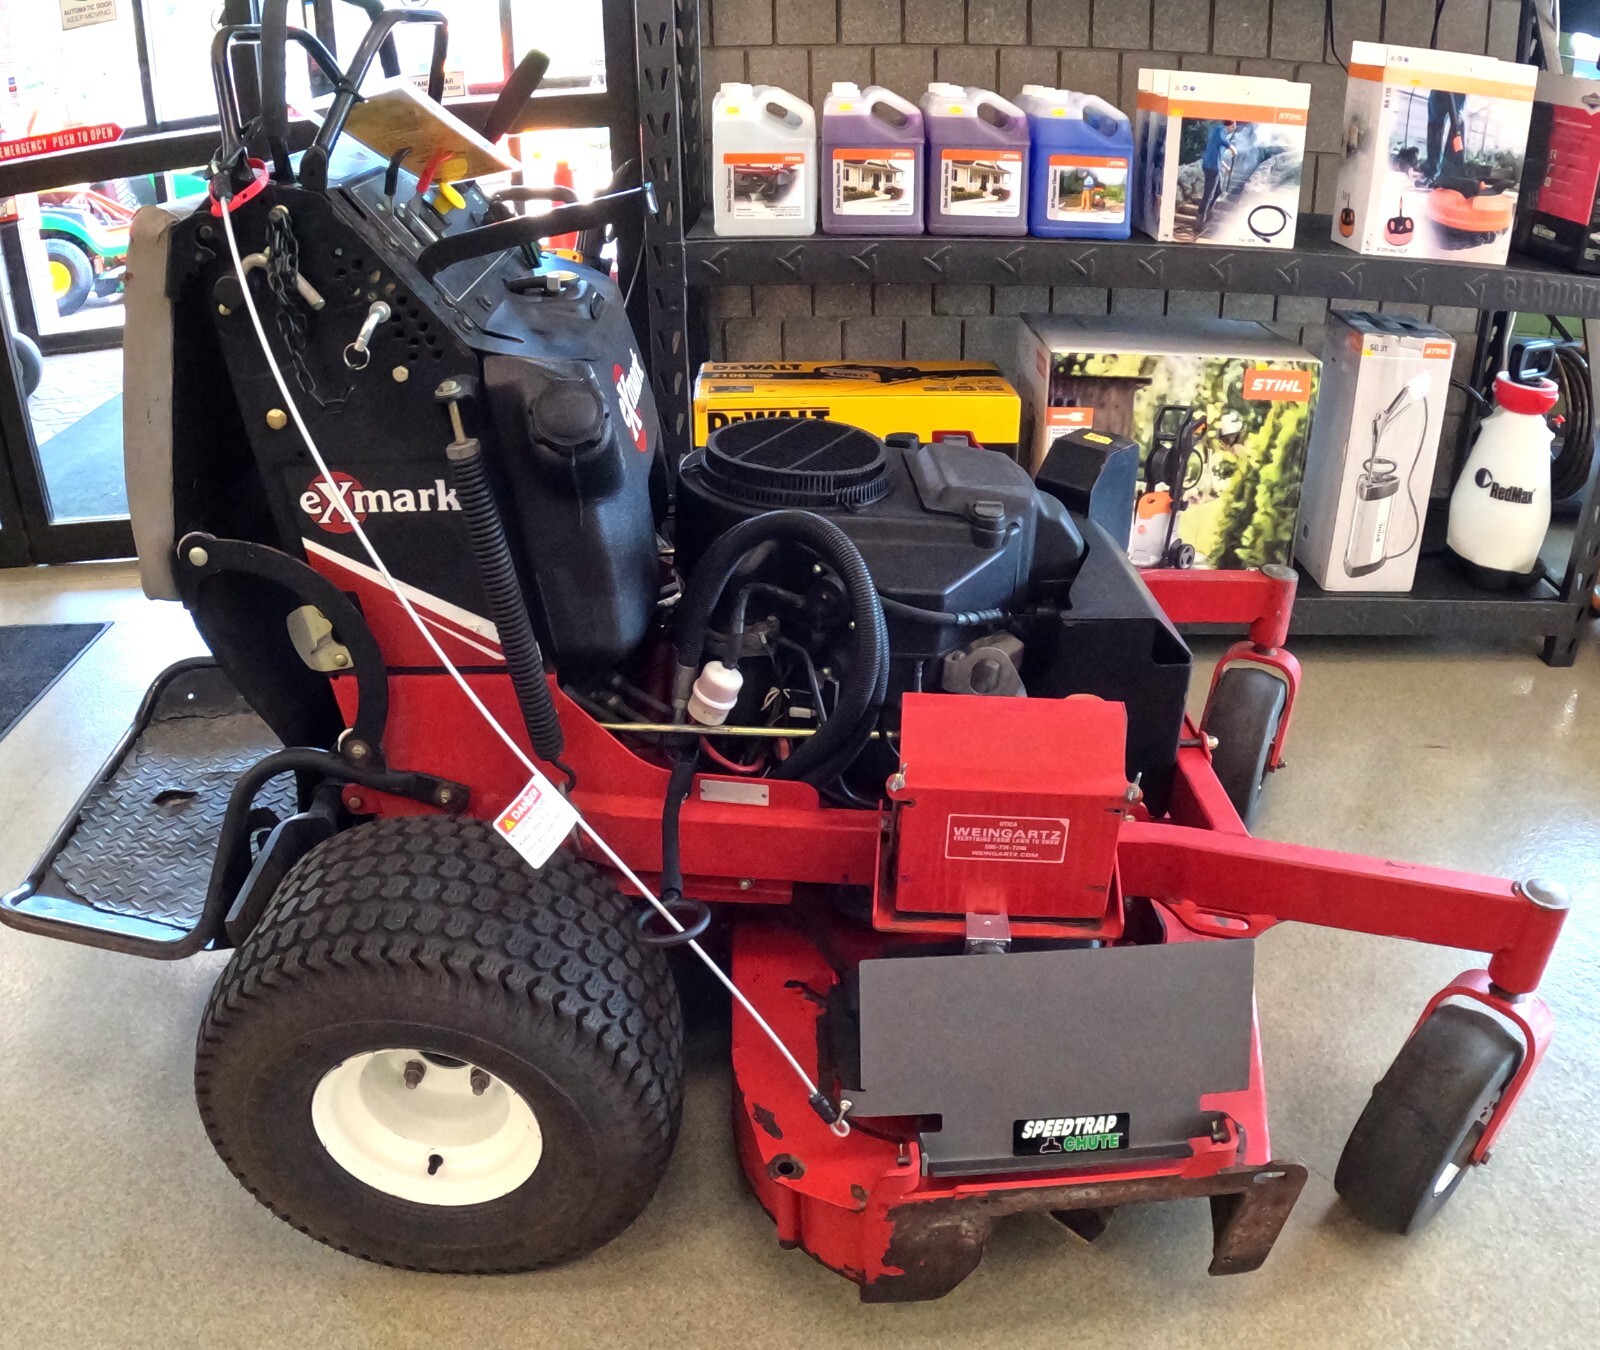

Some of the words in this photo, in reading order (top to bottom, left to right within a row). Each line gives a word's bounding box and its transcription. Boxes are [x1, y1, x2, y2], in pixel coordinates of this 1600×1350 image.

[64, 4, 95, 15] AUTOMATIC
[96, 1, 112, 9] DOOR
[67, 14, 84, 23] KEEP
[85, 9, 111, 19] MOVING
[1278, 112, 1304, 121] STIHL
[0, 138, 47, 158] EMERGENCY
[52, 132, 76, 148] PUSH
[77, 130, 88, 144] TO
[90, 126, 114, 141] OPEN
[1369, 343, 1379, 351] SG
[1424, 346, 1449, 355] STIHL
[1250, 378, 1303, 393] STIHL
[1490, 481, 1534, 505] RedMax
[511, 787, 541, 821] DANGER
[953, 826, 1061, 840] WEINGARTZ
[1021, 1115, 1117, 1139] SPEEDTRAP
[1063, 1134, 1120, 1152] CHUTE
